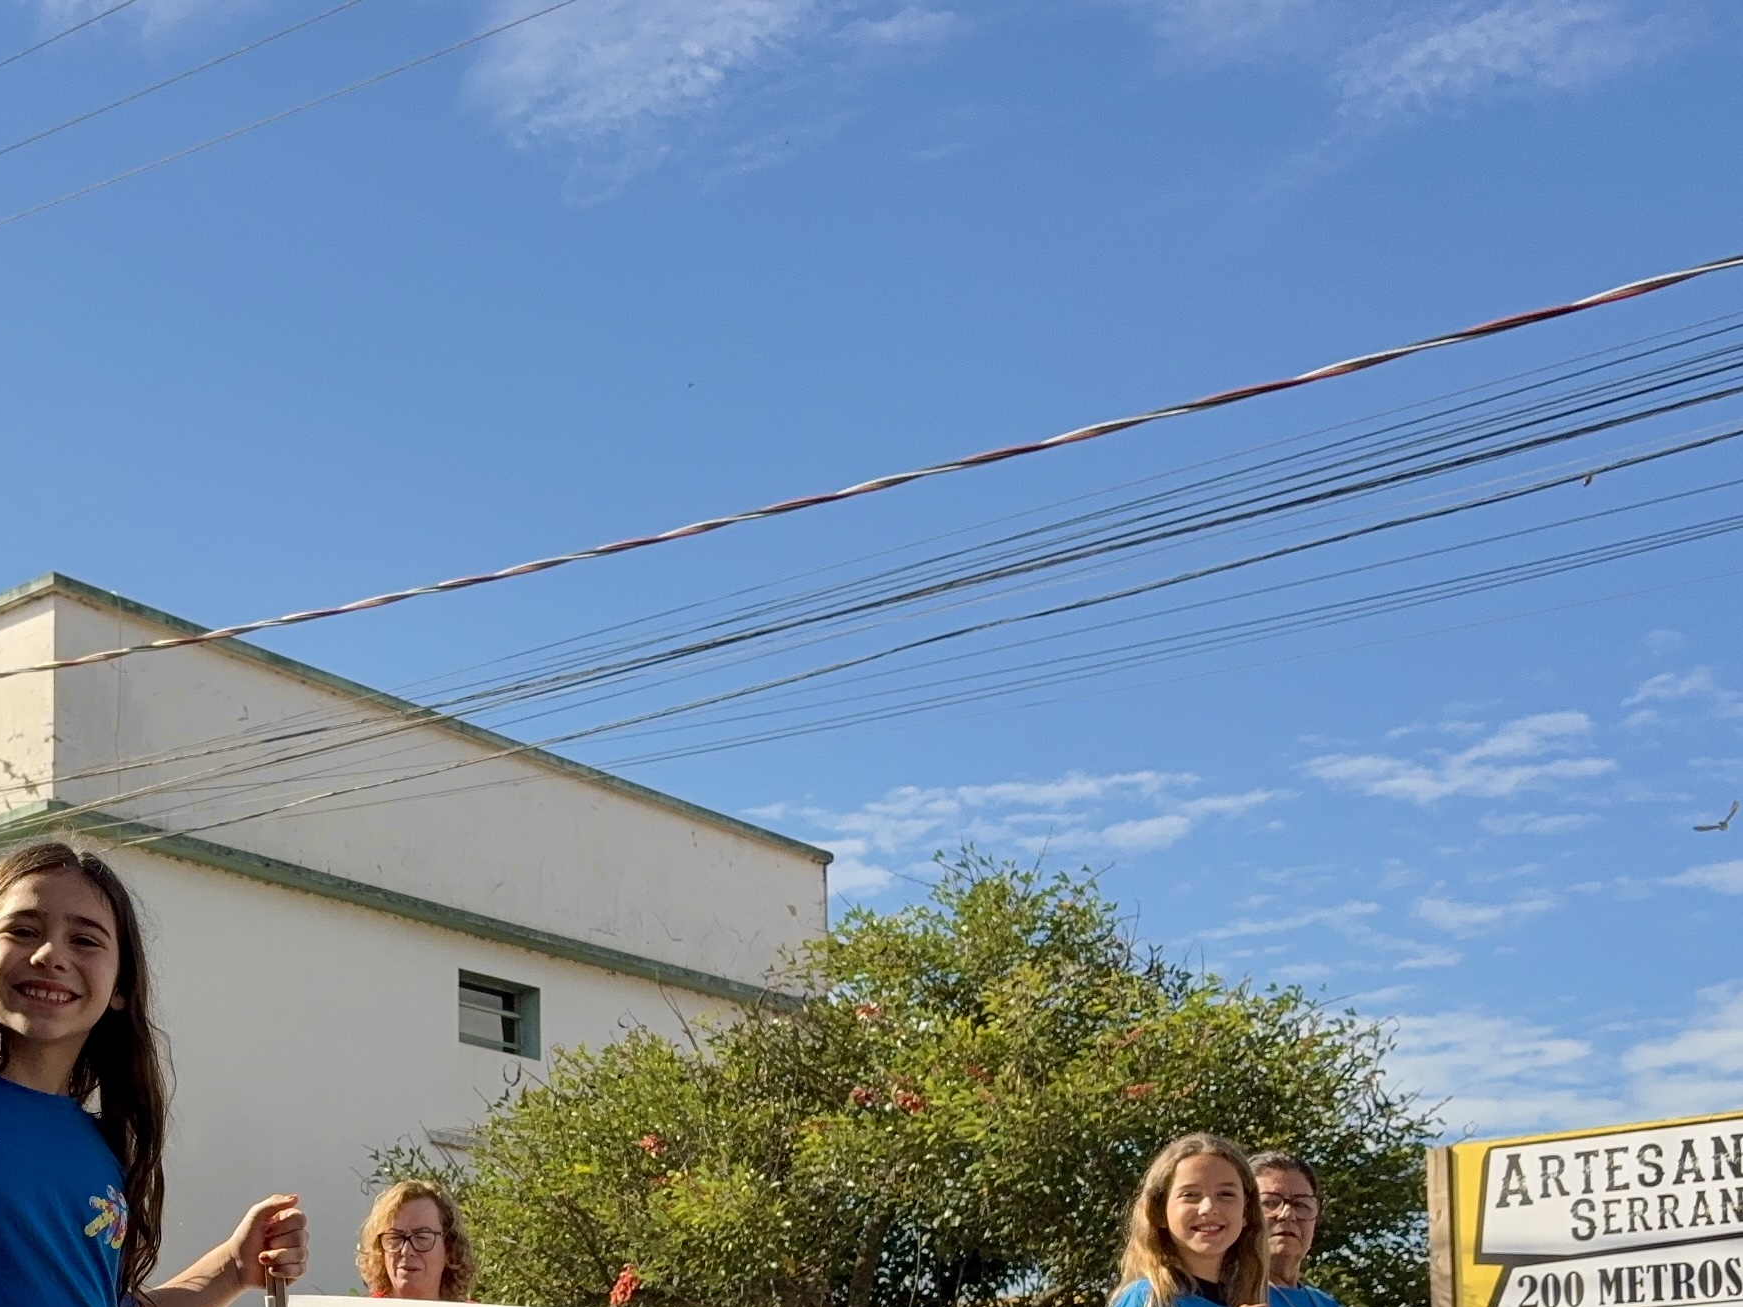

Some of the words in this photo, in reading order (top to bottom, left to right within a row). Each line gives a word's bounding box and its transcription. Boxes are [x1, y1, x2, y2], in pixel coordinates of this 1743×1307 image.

[1496, 1134, 1743, 1208] ARTESAN
[1570, 1188, 1743, 1241] SERRAN
[1598, 1257, 1743, 1306] METROS
